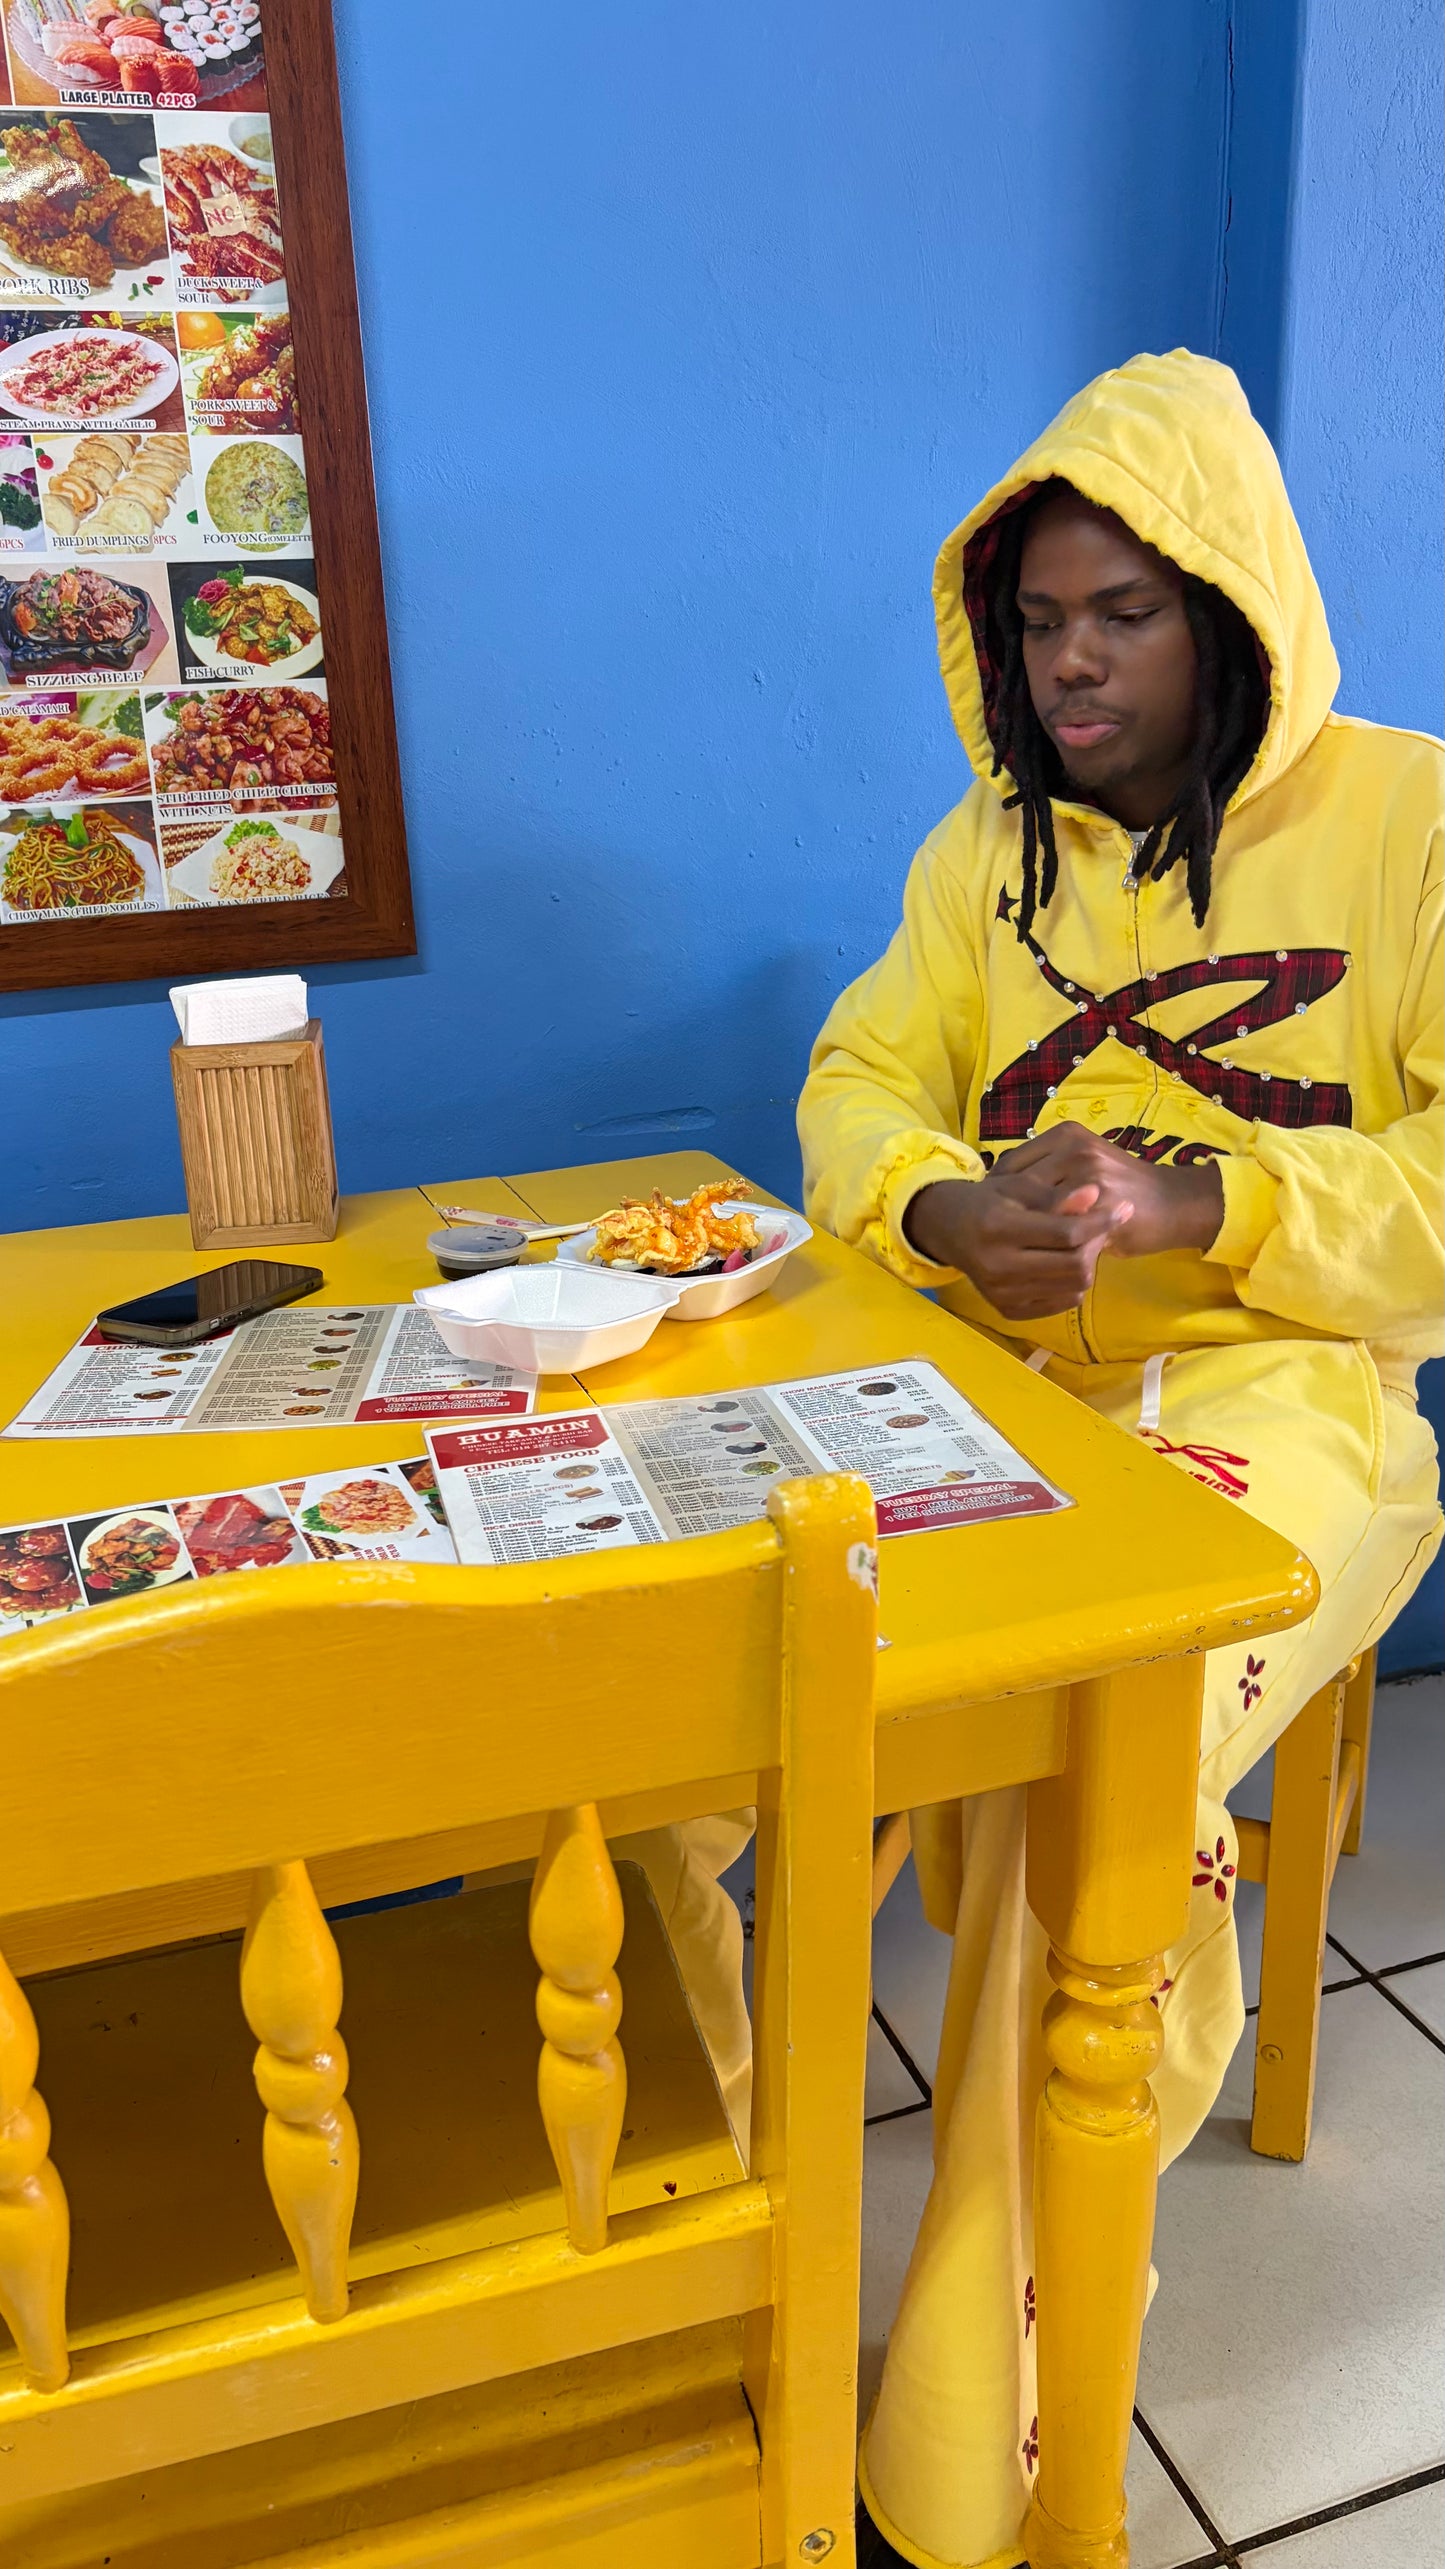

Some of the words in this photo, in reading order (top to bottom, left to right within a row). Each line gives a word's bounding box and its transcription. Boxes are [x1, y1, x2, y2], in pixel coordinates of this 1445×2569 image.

[61, 91, 98, 103] LARGE
[101, 92, 151, 105] PLATTER
[158, 93, 195, 106] 42PCS
[49, 278, 90, 294] RIBS
[177, 277, 209, 288] DUCK
[210, 277, 253, 288] SWEET
[255, 279, 263, 288] &
[178, 293, 210, 303] SOUR
[190, 400, 221, 410] PORK
[223, 400, 266, 410] SWEET
[268, 400, 277, 410] &
[0, 421, 38, 429] STEAM
[40, 421, 81, 429] PRAWN
[83, 421, 113, 429] WITH
[115, 421, 156, 429] GARLIC
[191, 415, 224, 426] SOUR
[52, 536, 84, 547] FRIED
[86, 535, 149, 546] DUMPLINGS
[153, 535, 177, 545] 8PCS
[26, 674, 98, 687] SIZZLING
[101, 671, 144, 683] BEEF
[186, 667, 213, 679] FISH
[215, 665, 256, 677] CURRY
[11, 704, 69, 715] CALAMARI
[156, 794, 187, 803] STIR
[188, 792, 231, 802] FRIED
[233, 788, 280, 799] CHILLI
[282, 784, 338, 796] CHICKEN
[159, 808, 195, 818] WITH
[198, 805, 232, 816] NUTS
[9, 912, 41, 921] CHOW
[42, 910, 70, 919] MAIN
[71, 906, 108, 917] (FRIED
[109, 902, 160, 913] NOODLES)
[382, 1394, 447, 1403] TUESDAY
[447, 1391, 507, 1399] SPECIAL
[456, 1418, 592, 1446] HUAMIN
[462, 1456, 545, 1473] CHINESE
[548, 1448, 601, 1461] FOOD
[878, 1492, 949, 1508] TUESDAY
[948, 1481, 1017, 1498] SPECIAL
[890, 1504, 921, 1514] BUY
[925, 1498, 964, 1509] MEAL
[959, 1494, 991, 1504] AND
[987, 1490, 1018, 1500] GET
[892, 1511, 923, 1521] VEG
[919, 1503, 970, 1517] SPRING
[965, 1498, 1003, 1509] ROLL
[997, 1493, 1037, 1504] FREE
[507, 1519, 544, 1528] DISHES
